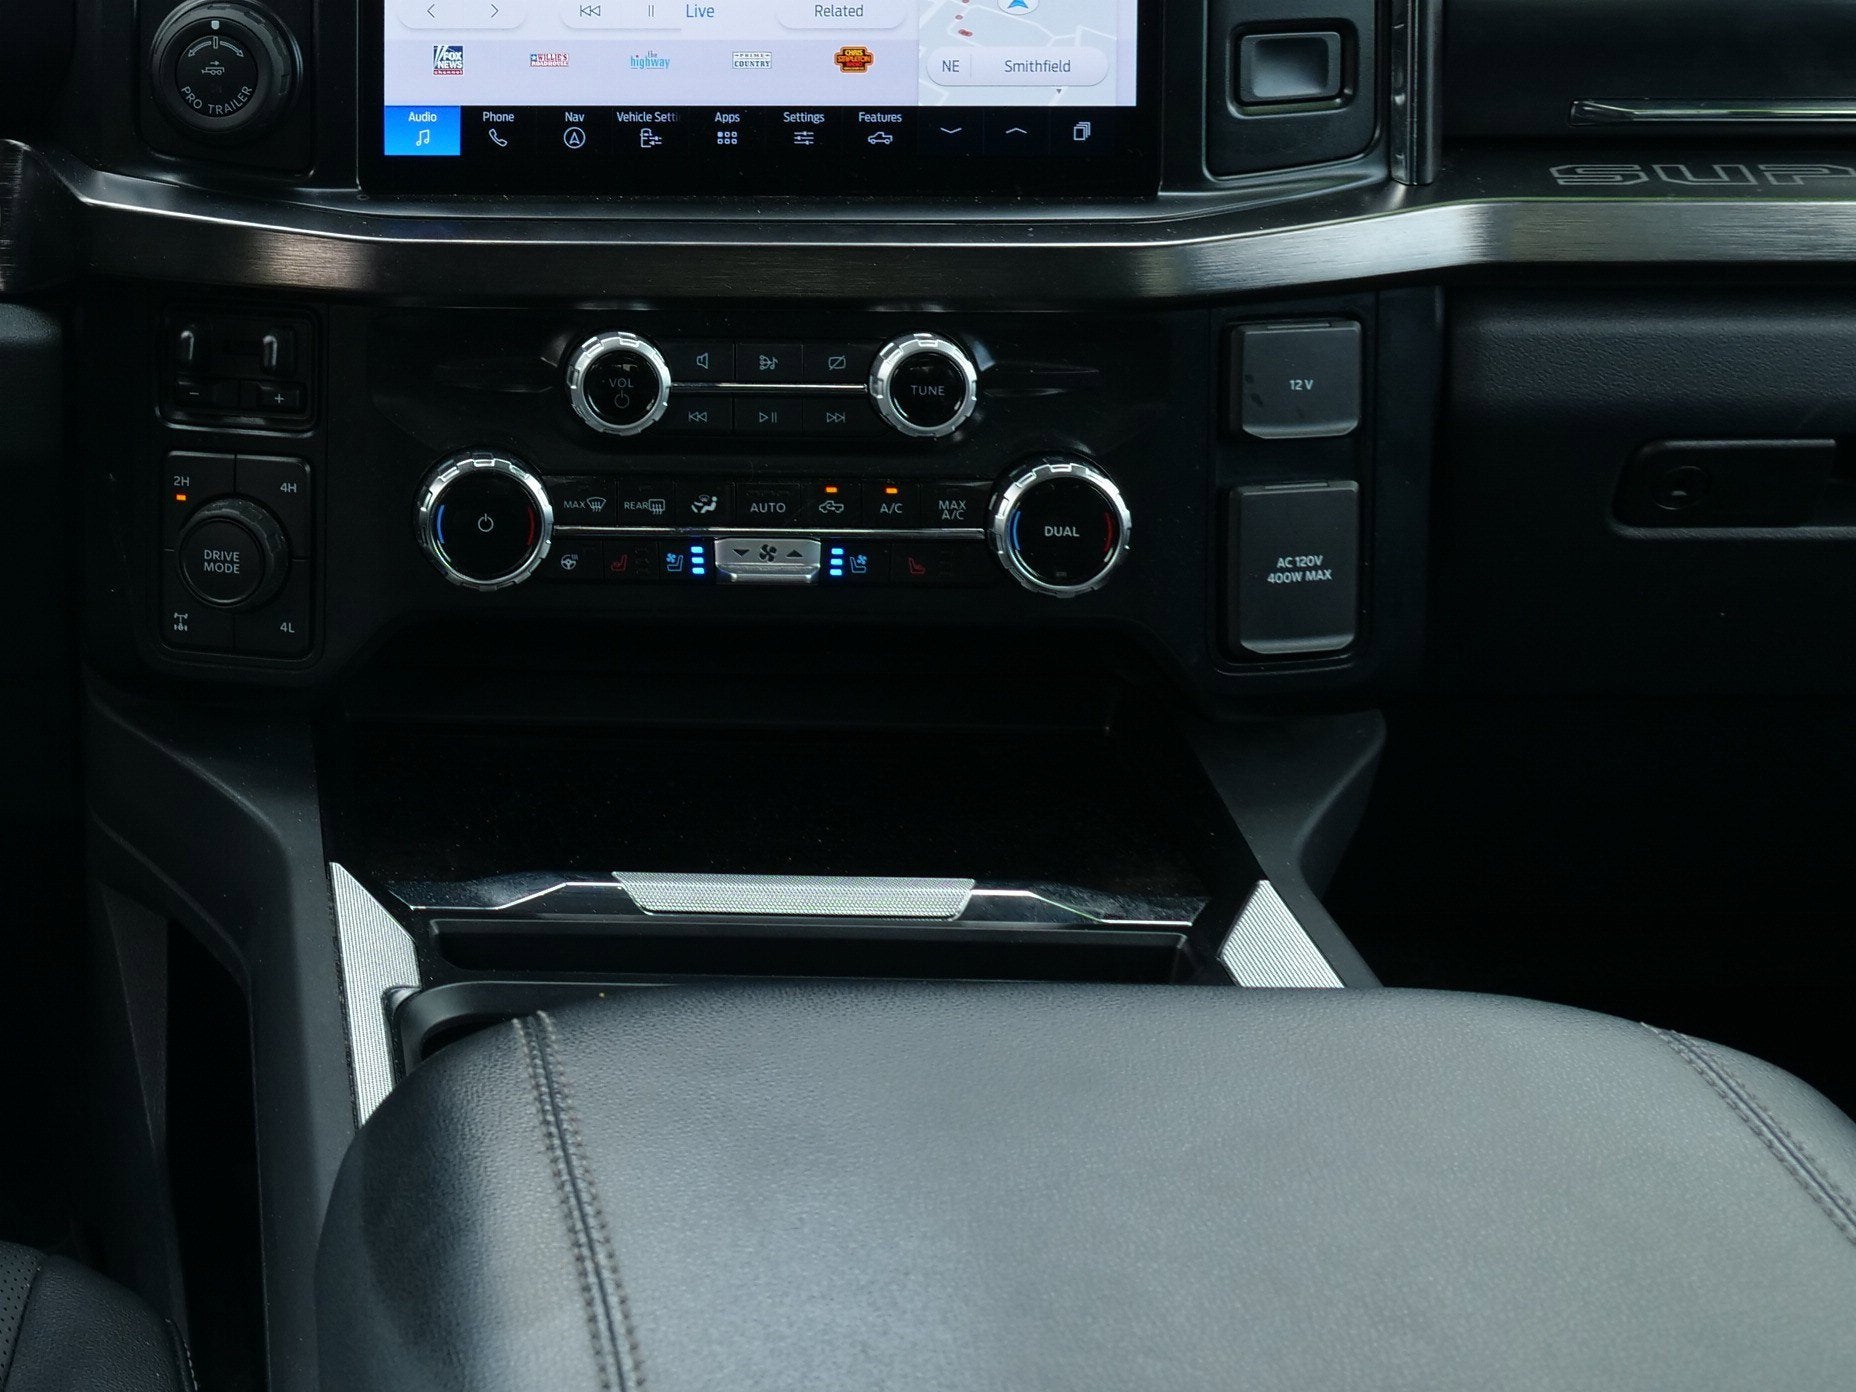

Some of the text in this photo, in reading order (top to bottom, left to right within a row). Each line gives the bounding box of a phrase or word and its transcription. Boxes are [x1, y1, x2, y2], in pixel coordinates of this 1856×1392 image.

[686, 4, 715, 19] Live
[814, 4, 864, 17] Related
[443, 51, 463, 60] FOX
[647, 50, 658, 58] the
[437, 60, 463, 69] NEWS
[630, 54, 671, 69] highway
[734, 60, 771, 68] COUNTRY
[942, 60, 960, 73] NE
[1004, 59, 1071, 73] Smithfield
[180, 85, 253, 115] PRO TRAILER
[408, 111, 437, 122] Audio
[483, 111, 515, 122] Phone
[565, 111, 585, 123] Nav
[616, 111, 653, 123] Vehicle
[714, 111, 741, 124] Apps
[783, 111, 825, 124] Settings
[858, 111, 903, 123] Features
[608, 377, 634, 389] VOL
[910, 385, 945, 396] TUNE
[173, 475, 190, 487] 2H
[280, 482, 298, 494] 4H
[563, 499, 586, 510] MAX
[624, 500, 649, 510] REAR
[750, 502, 786, 514] AUTO
[880, 502, 903, 514] A/C
[938, 499, 967, 511] MAX
[941, 509, 965, 521] A/C
[1044, 525, 1080, 538] DUAL
[204, 549, 240, 562] DRIVE
[1276, 555, 1323, 568] AC 120V
[204, 561, 240, 574] MODE
[1267, 569, 1333, 584] 400W MAX
[280, 621, 296, 633] 4L
